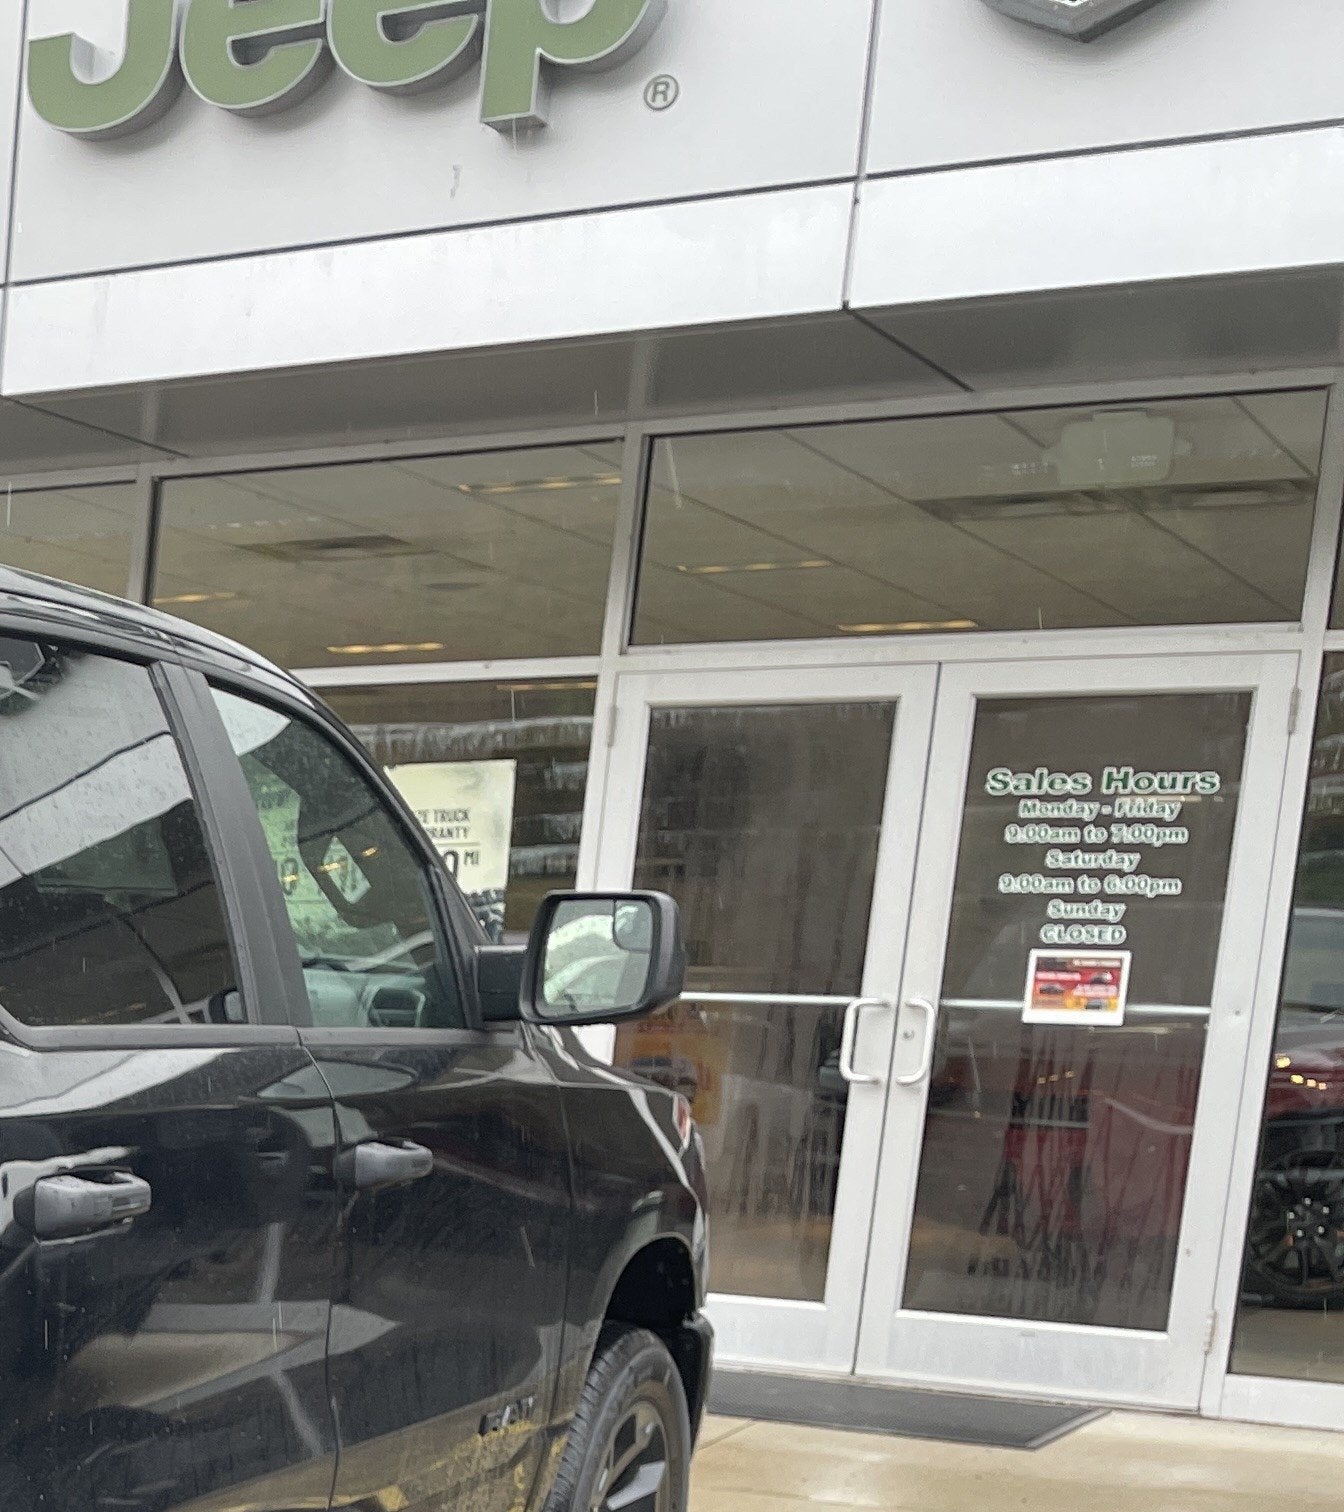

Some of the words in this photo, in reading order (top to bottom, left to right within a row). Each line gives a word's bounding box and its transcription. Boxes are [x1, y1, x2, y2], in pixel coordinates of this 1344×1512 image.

[985, 767, 1092, 796] Sales
[1101, 766, 1220, 795] Hours
[432, 808, 470, 823] TRUCK
[1018, 799, 1100, 821] Monday
[1114, 798, 1182, 822] Friday
[1083, 825, 1108, 843] to
[463, 850, 480, 866] MI
[1044, 849, 1141, 873] Saturday
[1076, 875, 1101, 894] to
[1047, 899, 1126, 922] Sunday
[1039, 924, 1127, 945] CLOSED
